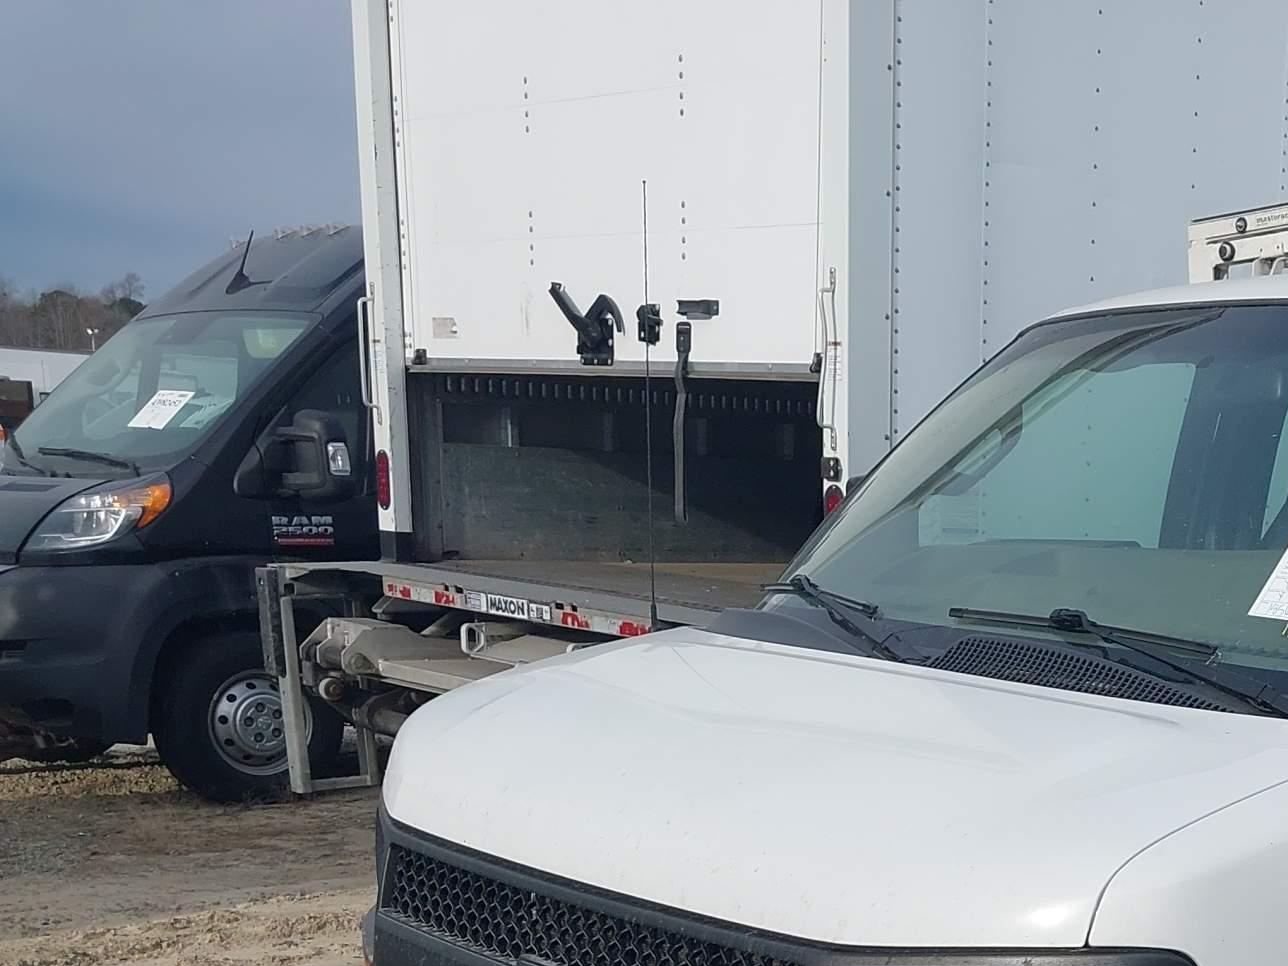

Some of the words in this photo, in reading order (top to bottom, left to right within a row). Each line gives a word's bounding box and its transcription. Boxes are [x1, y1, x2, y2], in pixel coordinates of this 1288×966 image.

[271, 516, 333, 526] RAM
[273, 525, 334, 536] 2500
[488, 596, 526, 617] MAXON
